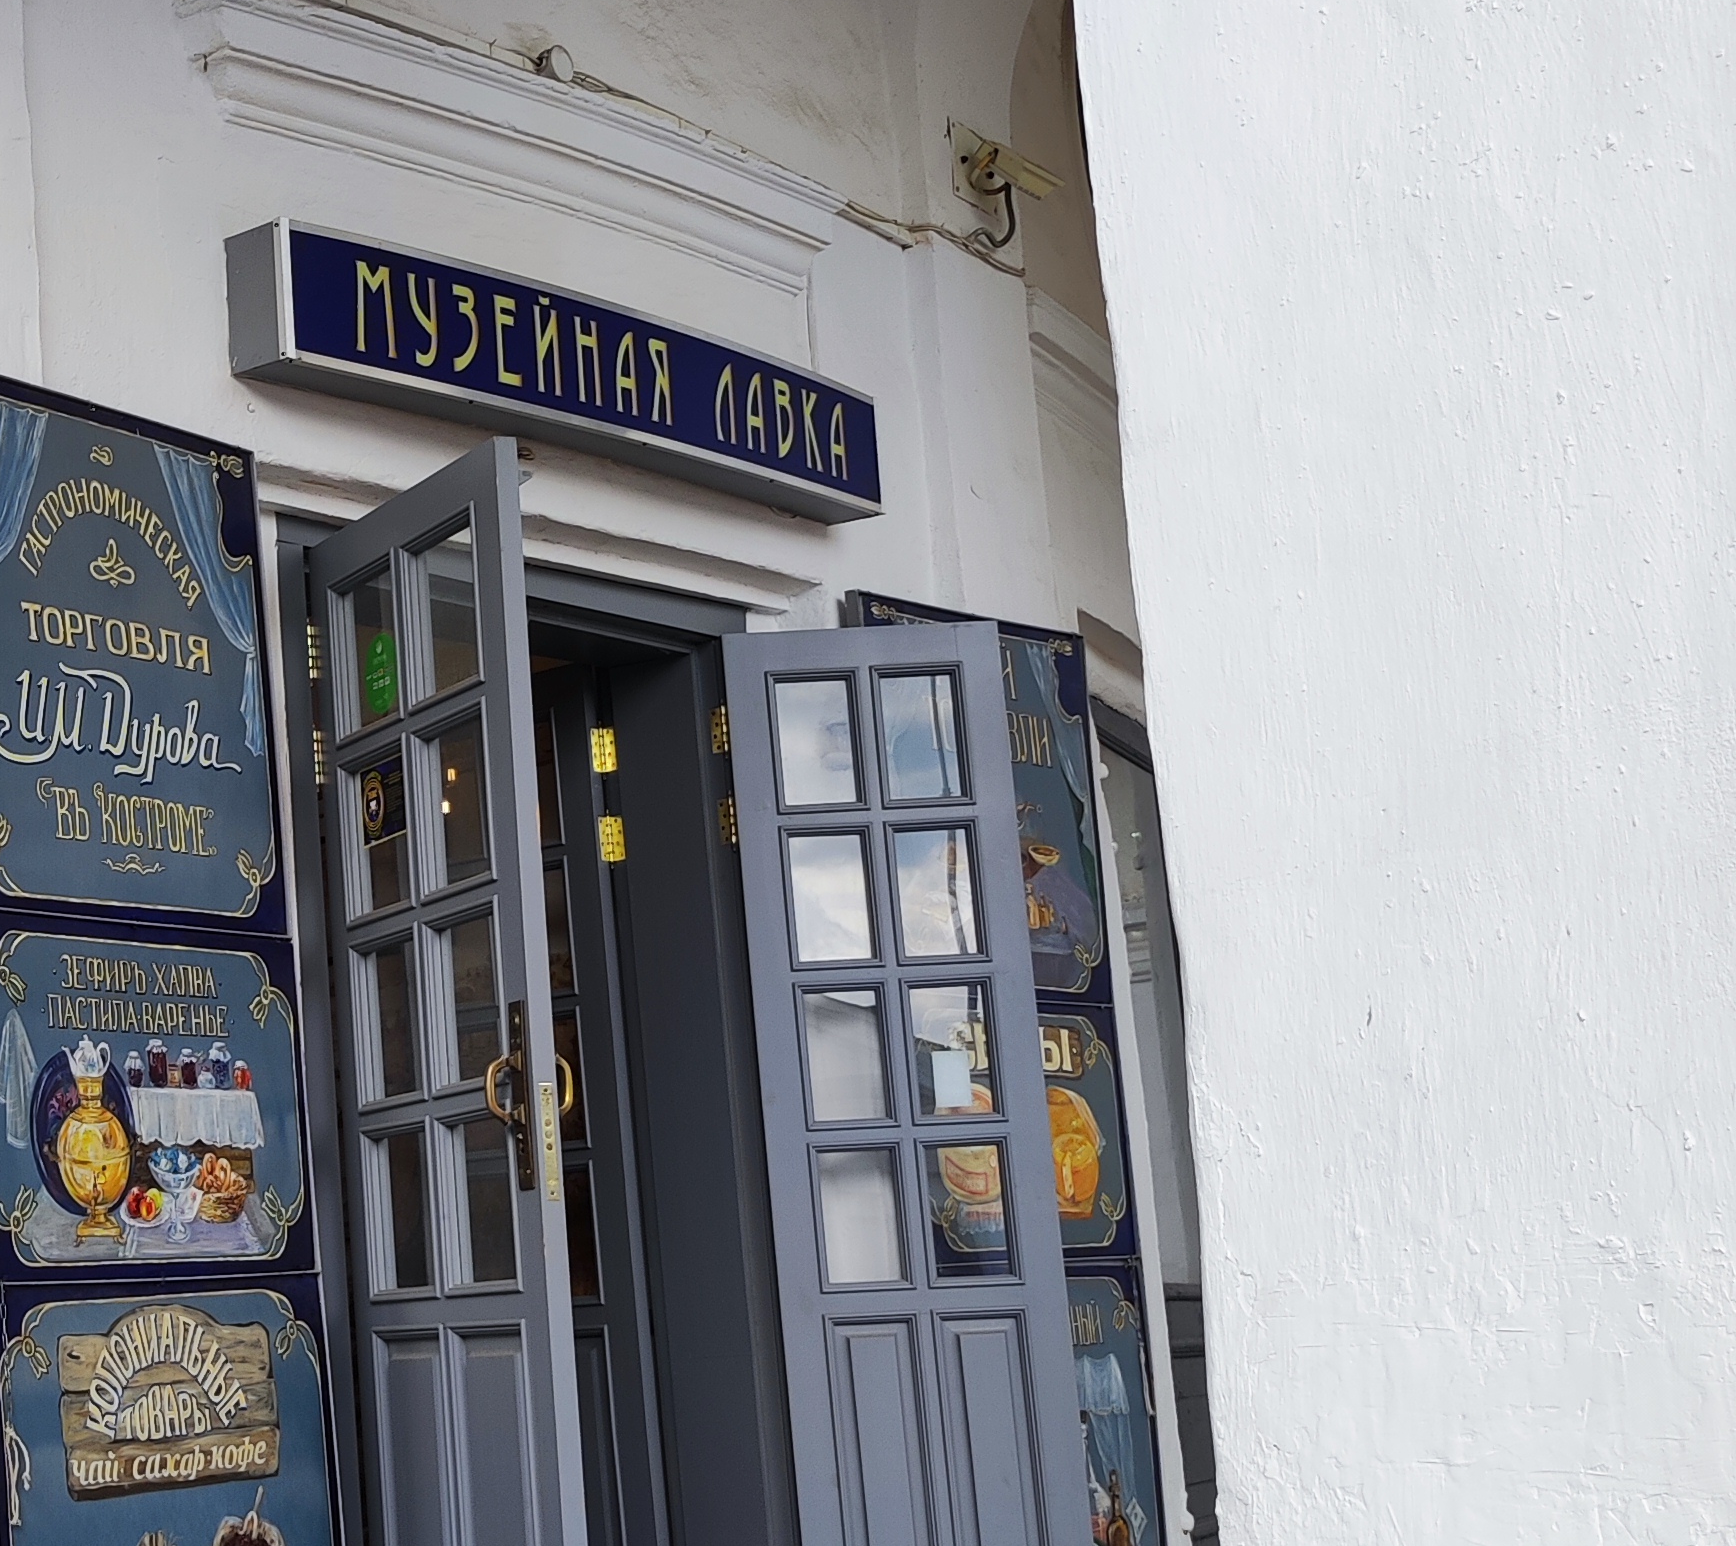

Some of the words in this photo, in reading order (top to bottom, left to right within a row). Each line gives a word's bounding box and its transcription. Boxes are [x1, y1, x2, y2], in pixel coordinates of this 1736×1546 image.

[355, 259, 672, 426] МУЗЕЙНАЯ
[715, 362, 848, 481] ЛАВКА
[18, 477, 202, 610] ГАСТРОНОМИЧЕСКАЯ
[20, 600, 213, 676] ТОРГОВЛЯ
[93, 782, 217, 856] КОСТРОМЕ
[60, 954, 147, 995] ЗЕФИРЪ
[47, 993, 139, 1034] ПАСТИЛА
[142, 1002, 229, 1038] ВАРЕНЬЕ
[86, 1312, 247, 1441] КОЛОНИАЛЬНЫЕ
[121, 1384, 212, 1441] ТОВАРЫ
[132, 1445, 203, 1481] сахар
[208, 1436, 267, 1472] кофе
